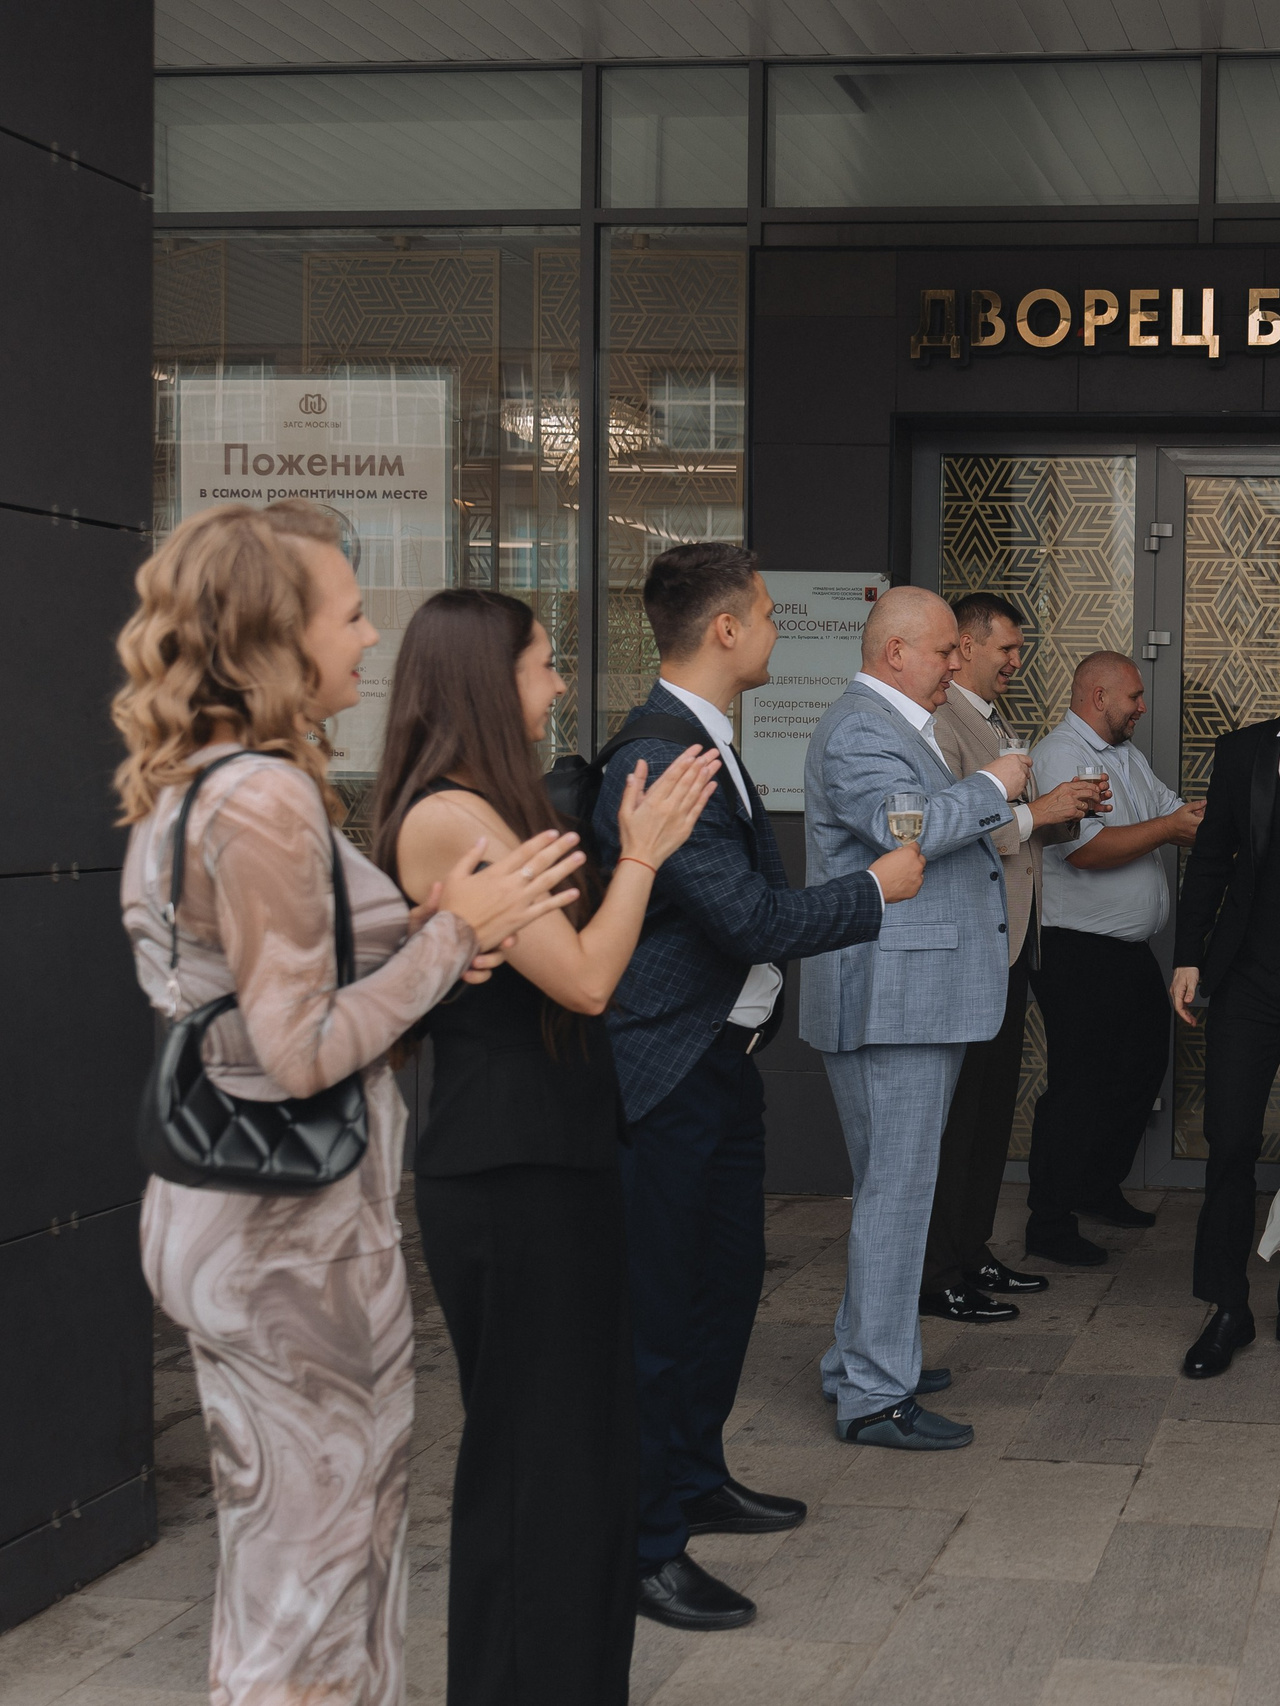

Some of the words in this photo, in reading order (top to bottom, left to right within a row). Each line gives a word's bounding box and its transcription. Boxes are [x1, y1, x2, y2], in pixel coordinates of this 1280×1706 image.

[910, 287, 1221, 359] ДВОРЕЦ
[283, 421, 303, 429] ЗАГС
[304, 421, 342, 429] МОСКВЫ
[223, 443, 405, 477] Поженим
[199, 488, 207, 498] в
[212, 487, 262, 499] самом
[267, 487, 377, 502] романтичном
[382, 488, 428, 500] месте
[773, 603, 808, 616] ОРЕЦ
[772, 620, 866, 632] КОСОЧЕТАНИ
[776, 676, 848, 685] ДЕЯТЕЛЬНОСТИ
[360, 690, 387, 698] олицы
[754, 697, 834, 711] Государственн
[753, 715, 820, 726] регистрация
[753, 730, 812, 739] заключени
